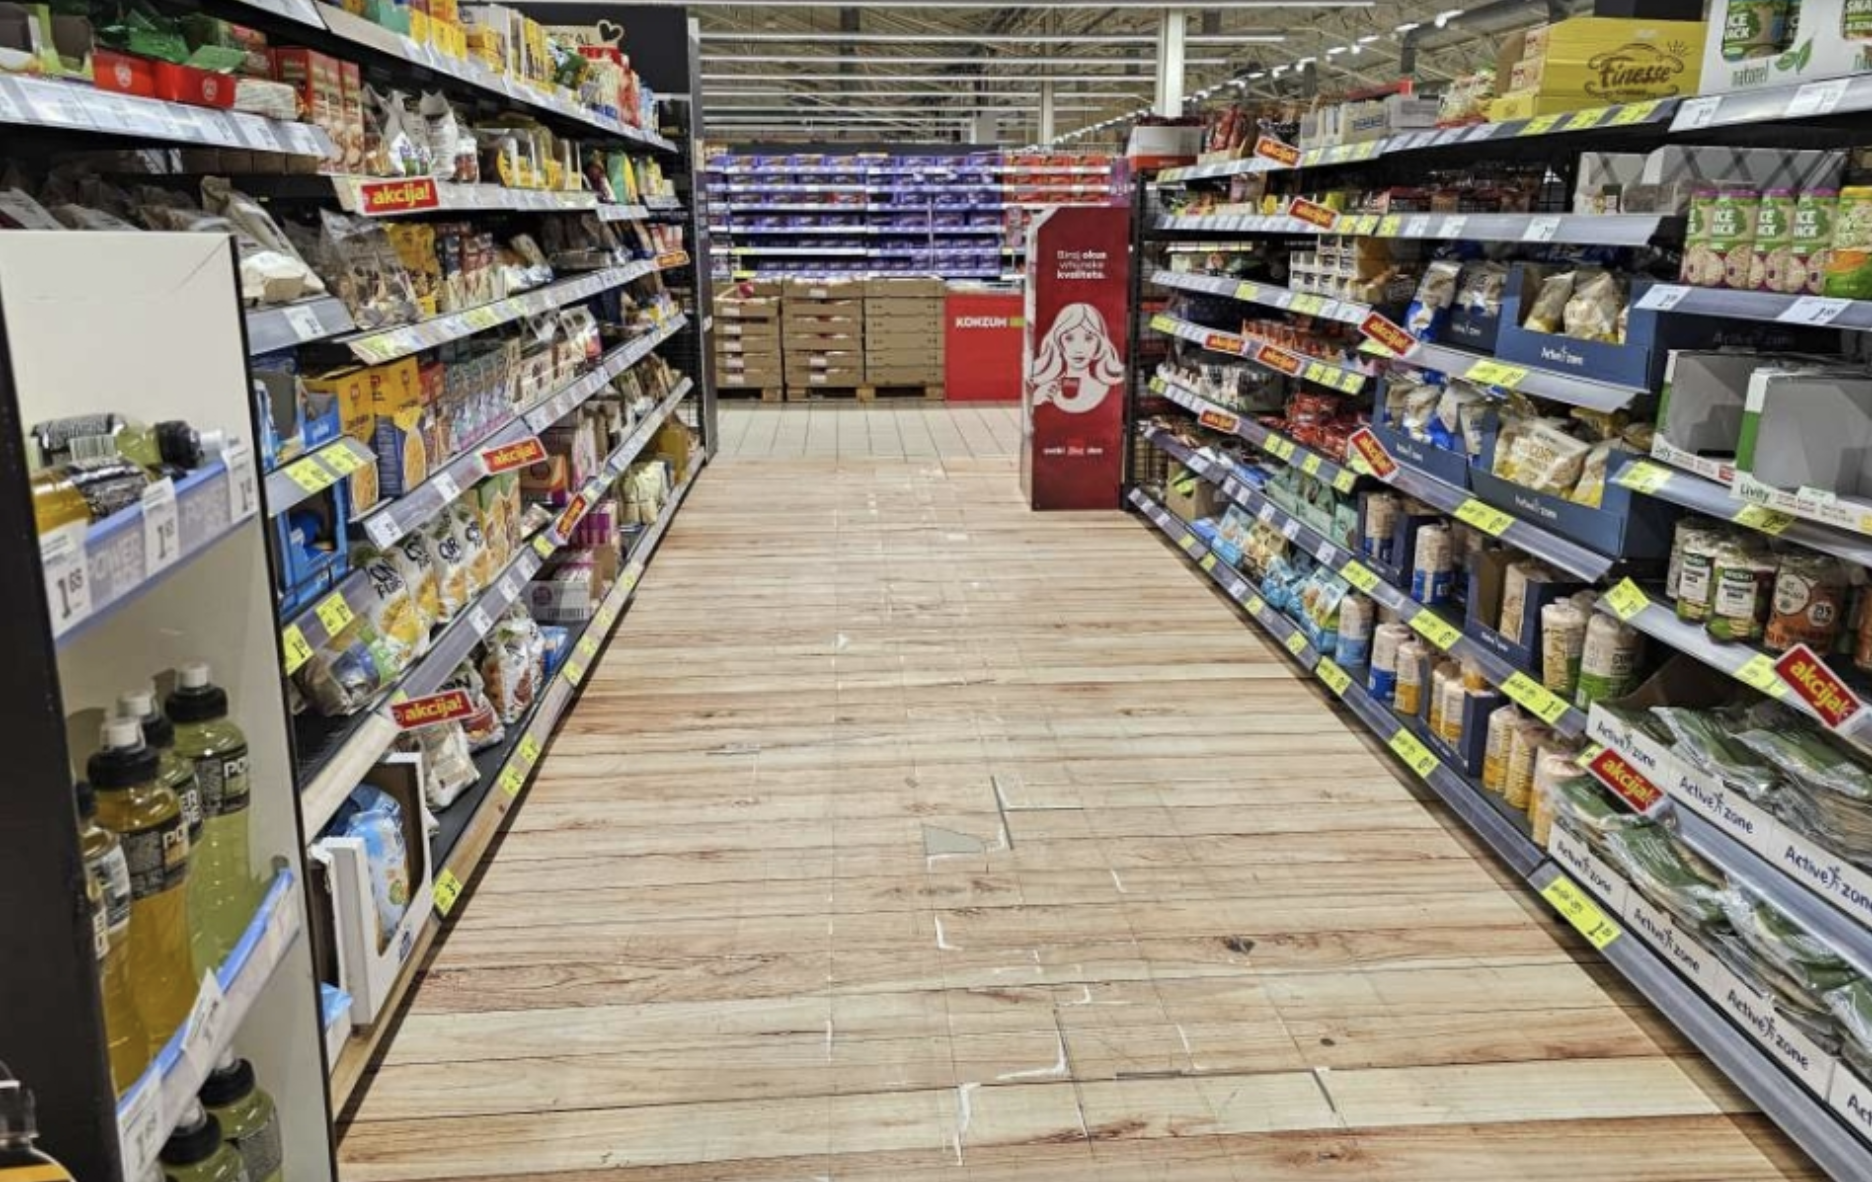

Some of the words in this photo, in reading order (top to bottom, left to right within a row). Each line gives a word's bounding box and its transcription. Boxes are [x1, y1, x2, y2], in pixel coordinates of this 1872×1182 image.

[1600, 56, 1670, 88] Finesse
[373, 181, 430, 207] akcija!
[956, 317, 1007, 329] KONZUM
[1740, 484, 1770, 504] Livity
[1789, 660, 1852, 717] akcija!
[405, 692, 464, 721] akcija!
[1632, 749, 1656, 771] zone
[1601, 758, 1656, 807] akcija!
[1680, 776, 1716, 811] Active
[1724, 806, 1754, 835] zone
[1785, 846, 1833, 886] Active
[1589, 871, 1612, 894] zone
[1673, 942, 1700, 974] zone
[1727, 989, 1770, 1033] Active
[1775, 1032, 1810, 1071] zone
